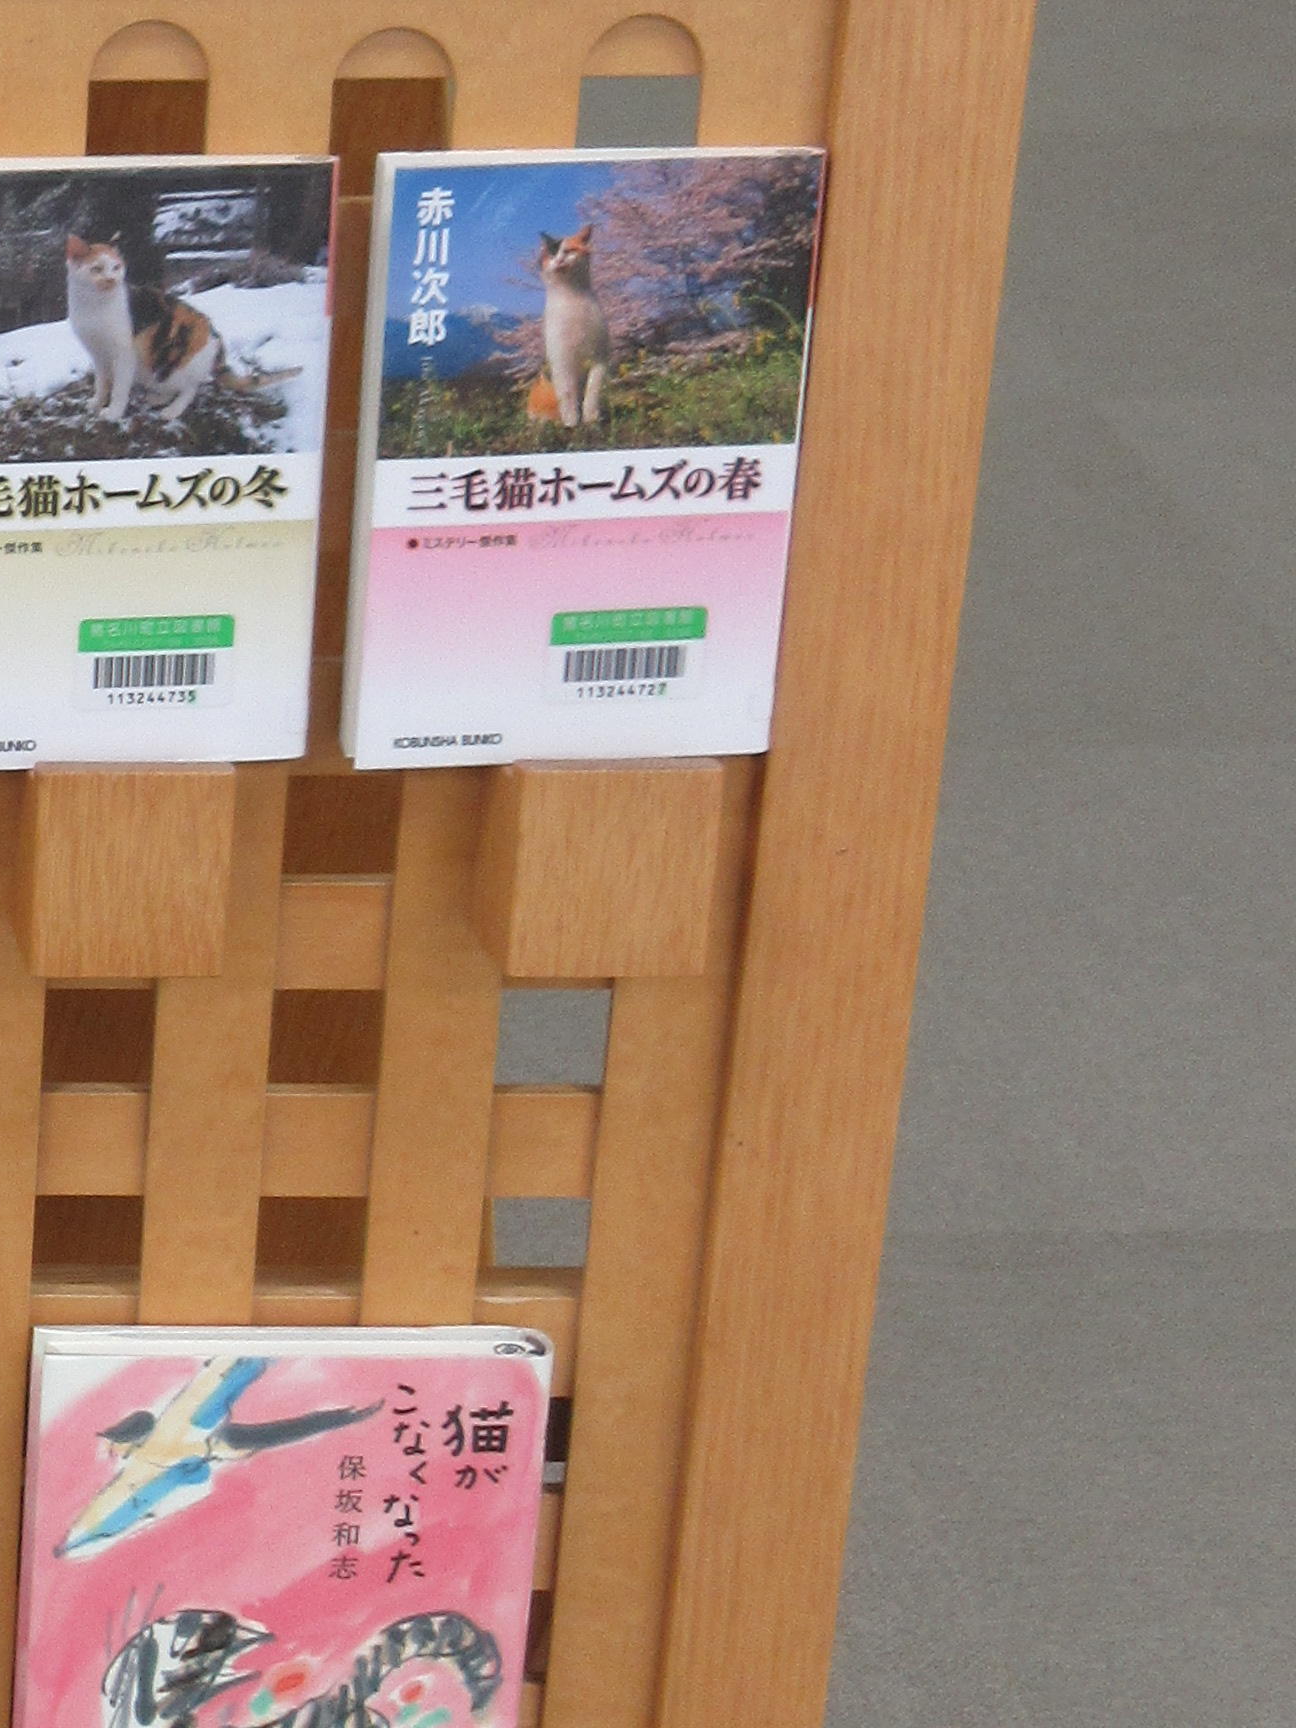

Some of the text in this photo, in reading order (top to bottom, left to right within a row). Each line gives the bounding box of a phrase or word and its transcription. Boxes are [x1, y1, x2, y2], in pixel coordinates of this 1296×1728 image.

[407, 187, 455, 348] 赤川次郎
[407, 456, 763, 514] 三毛猫ホームズの春
[106, 689, 197, 706] 113244735
[576, 683, 667, 699] 113244727
[393, 733, 502, 750] KOBUNSHA BUNKO
[441, 1400, 514, 1490] 猫が
[330, 1454, 368, 1580] 保坂和志
[383, 1383, 431, 1584] こなくなった
